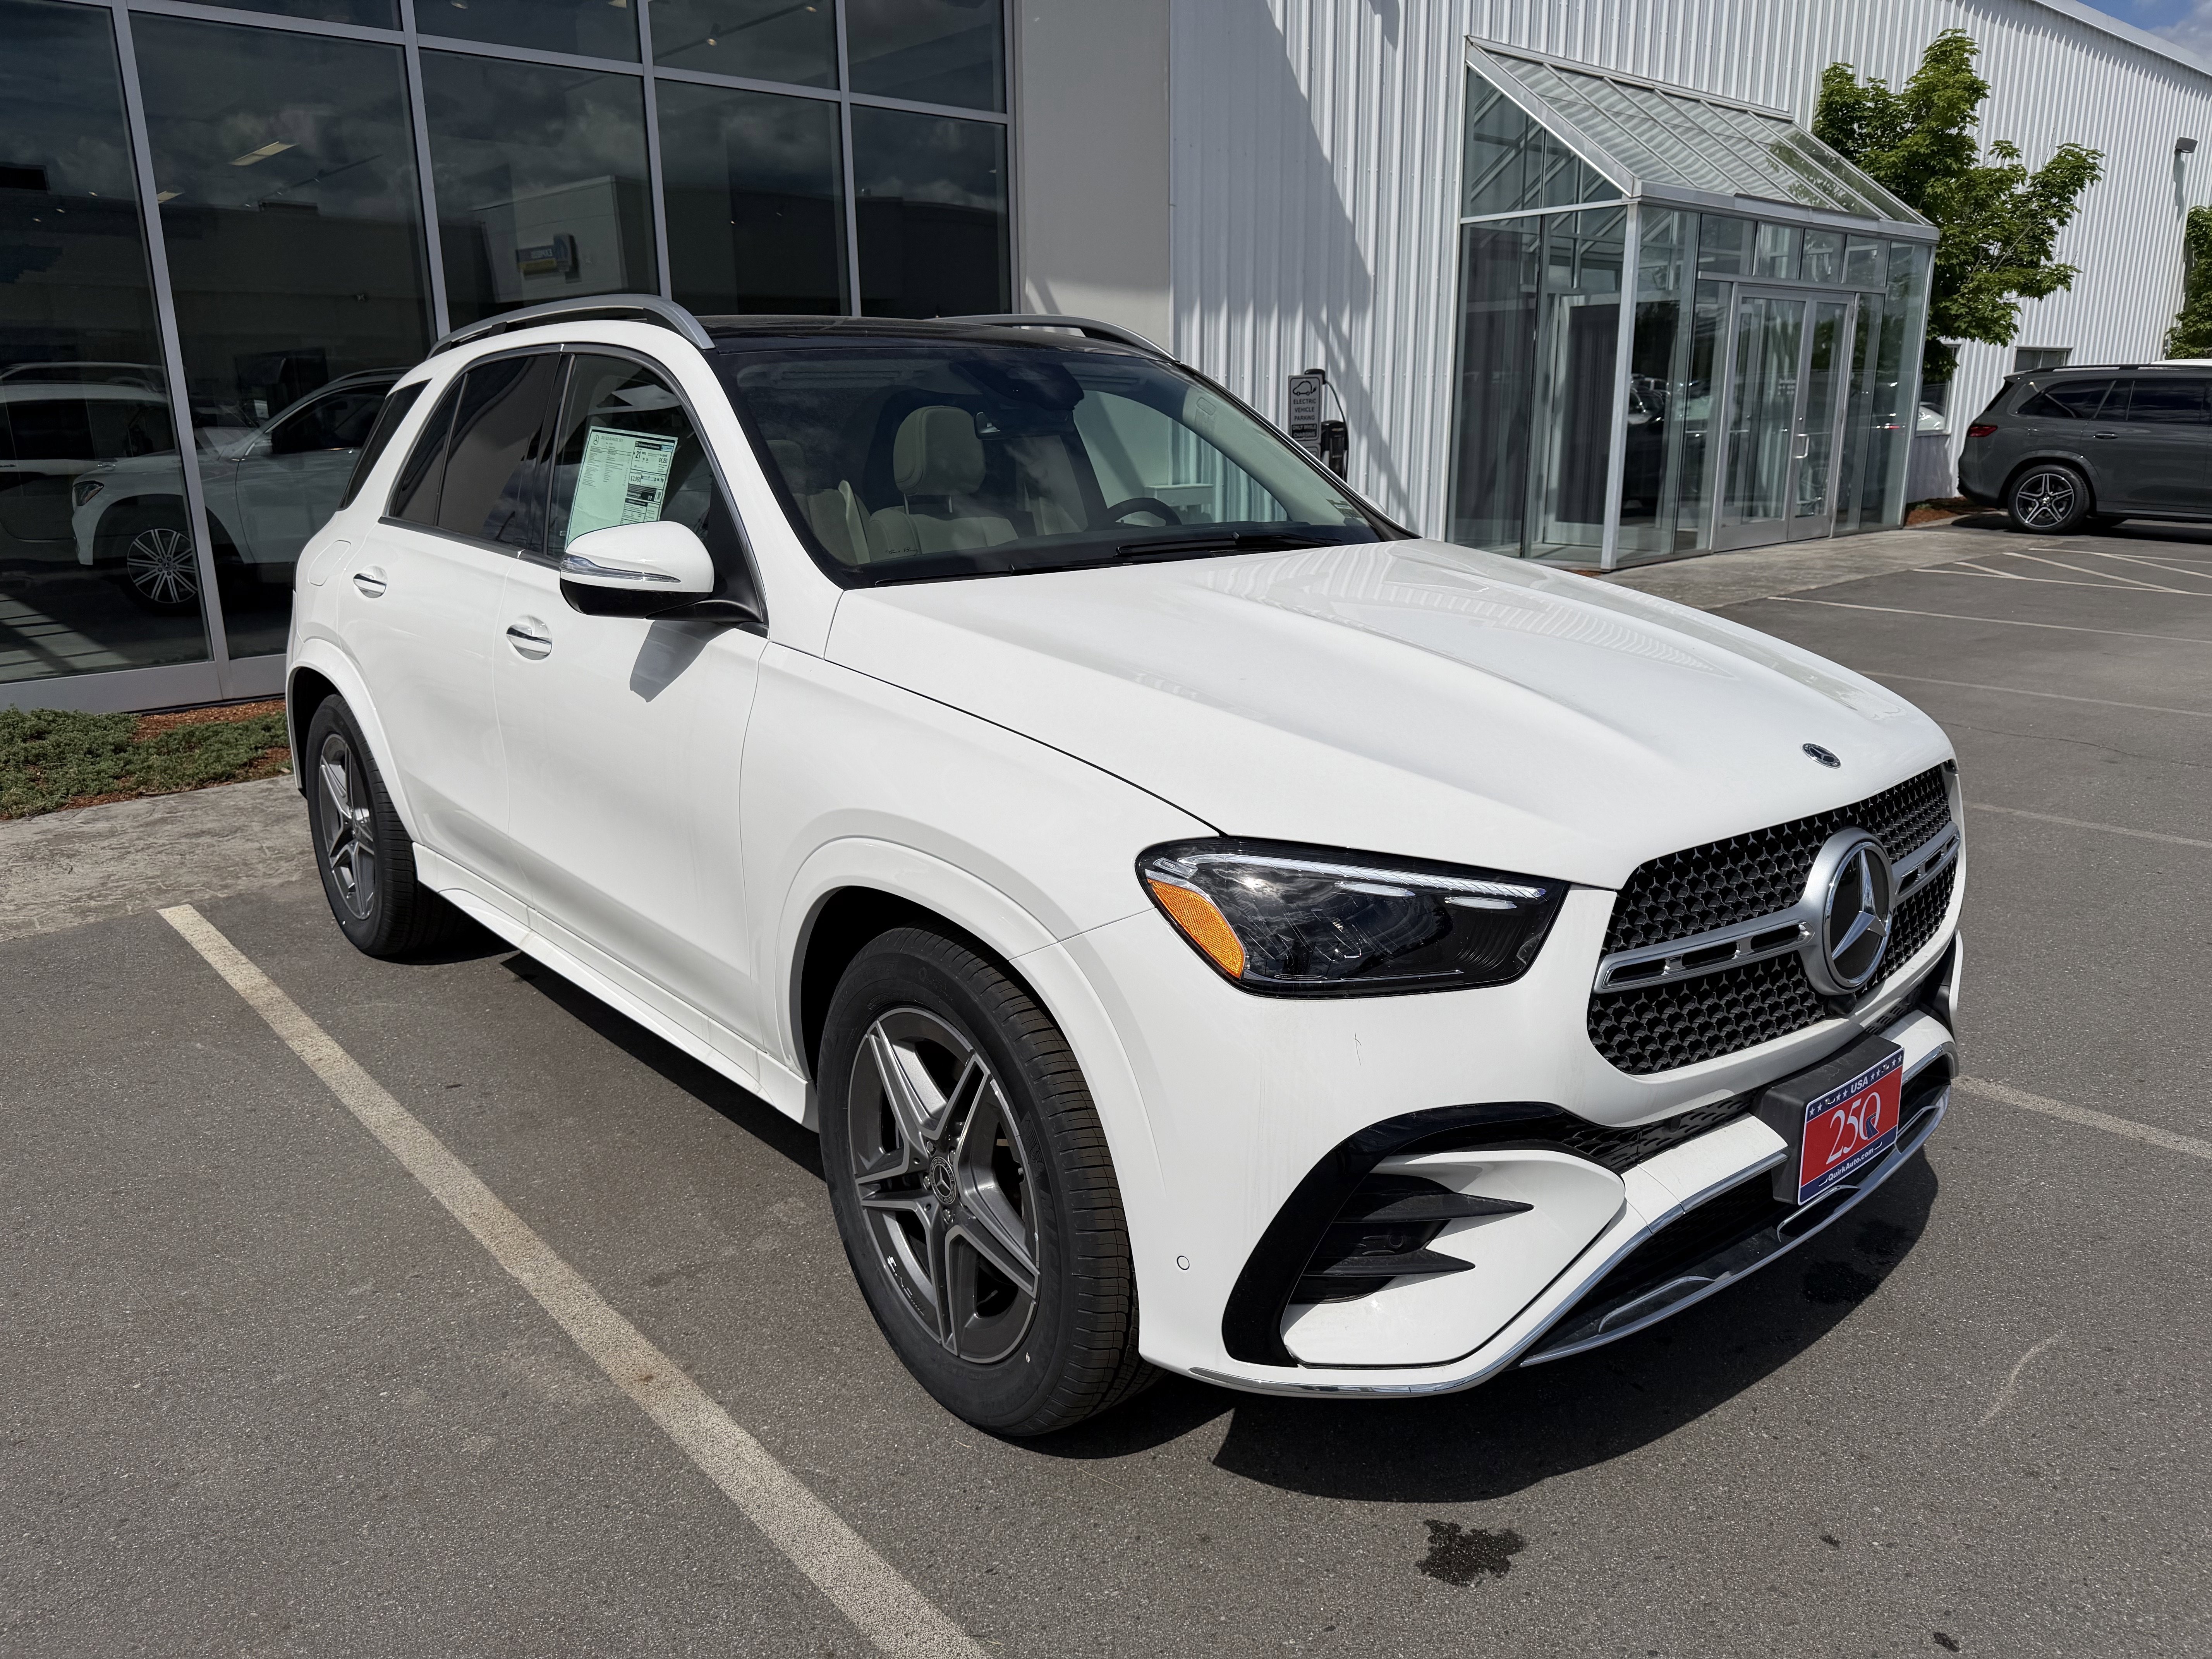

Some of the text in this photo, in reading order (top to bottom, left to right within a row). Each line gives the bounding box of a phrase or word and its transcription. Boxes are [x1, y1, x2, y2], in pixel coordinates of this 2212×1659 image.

[635, 451, 641, 459] 21
[1851, 1076, 1868, 1093] USA
[1826, 1092, 1881, 1165] 250
[1828, 1148, 1874, 1181] QuirkAuto.com
